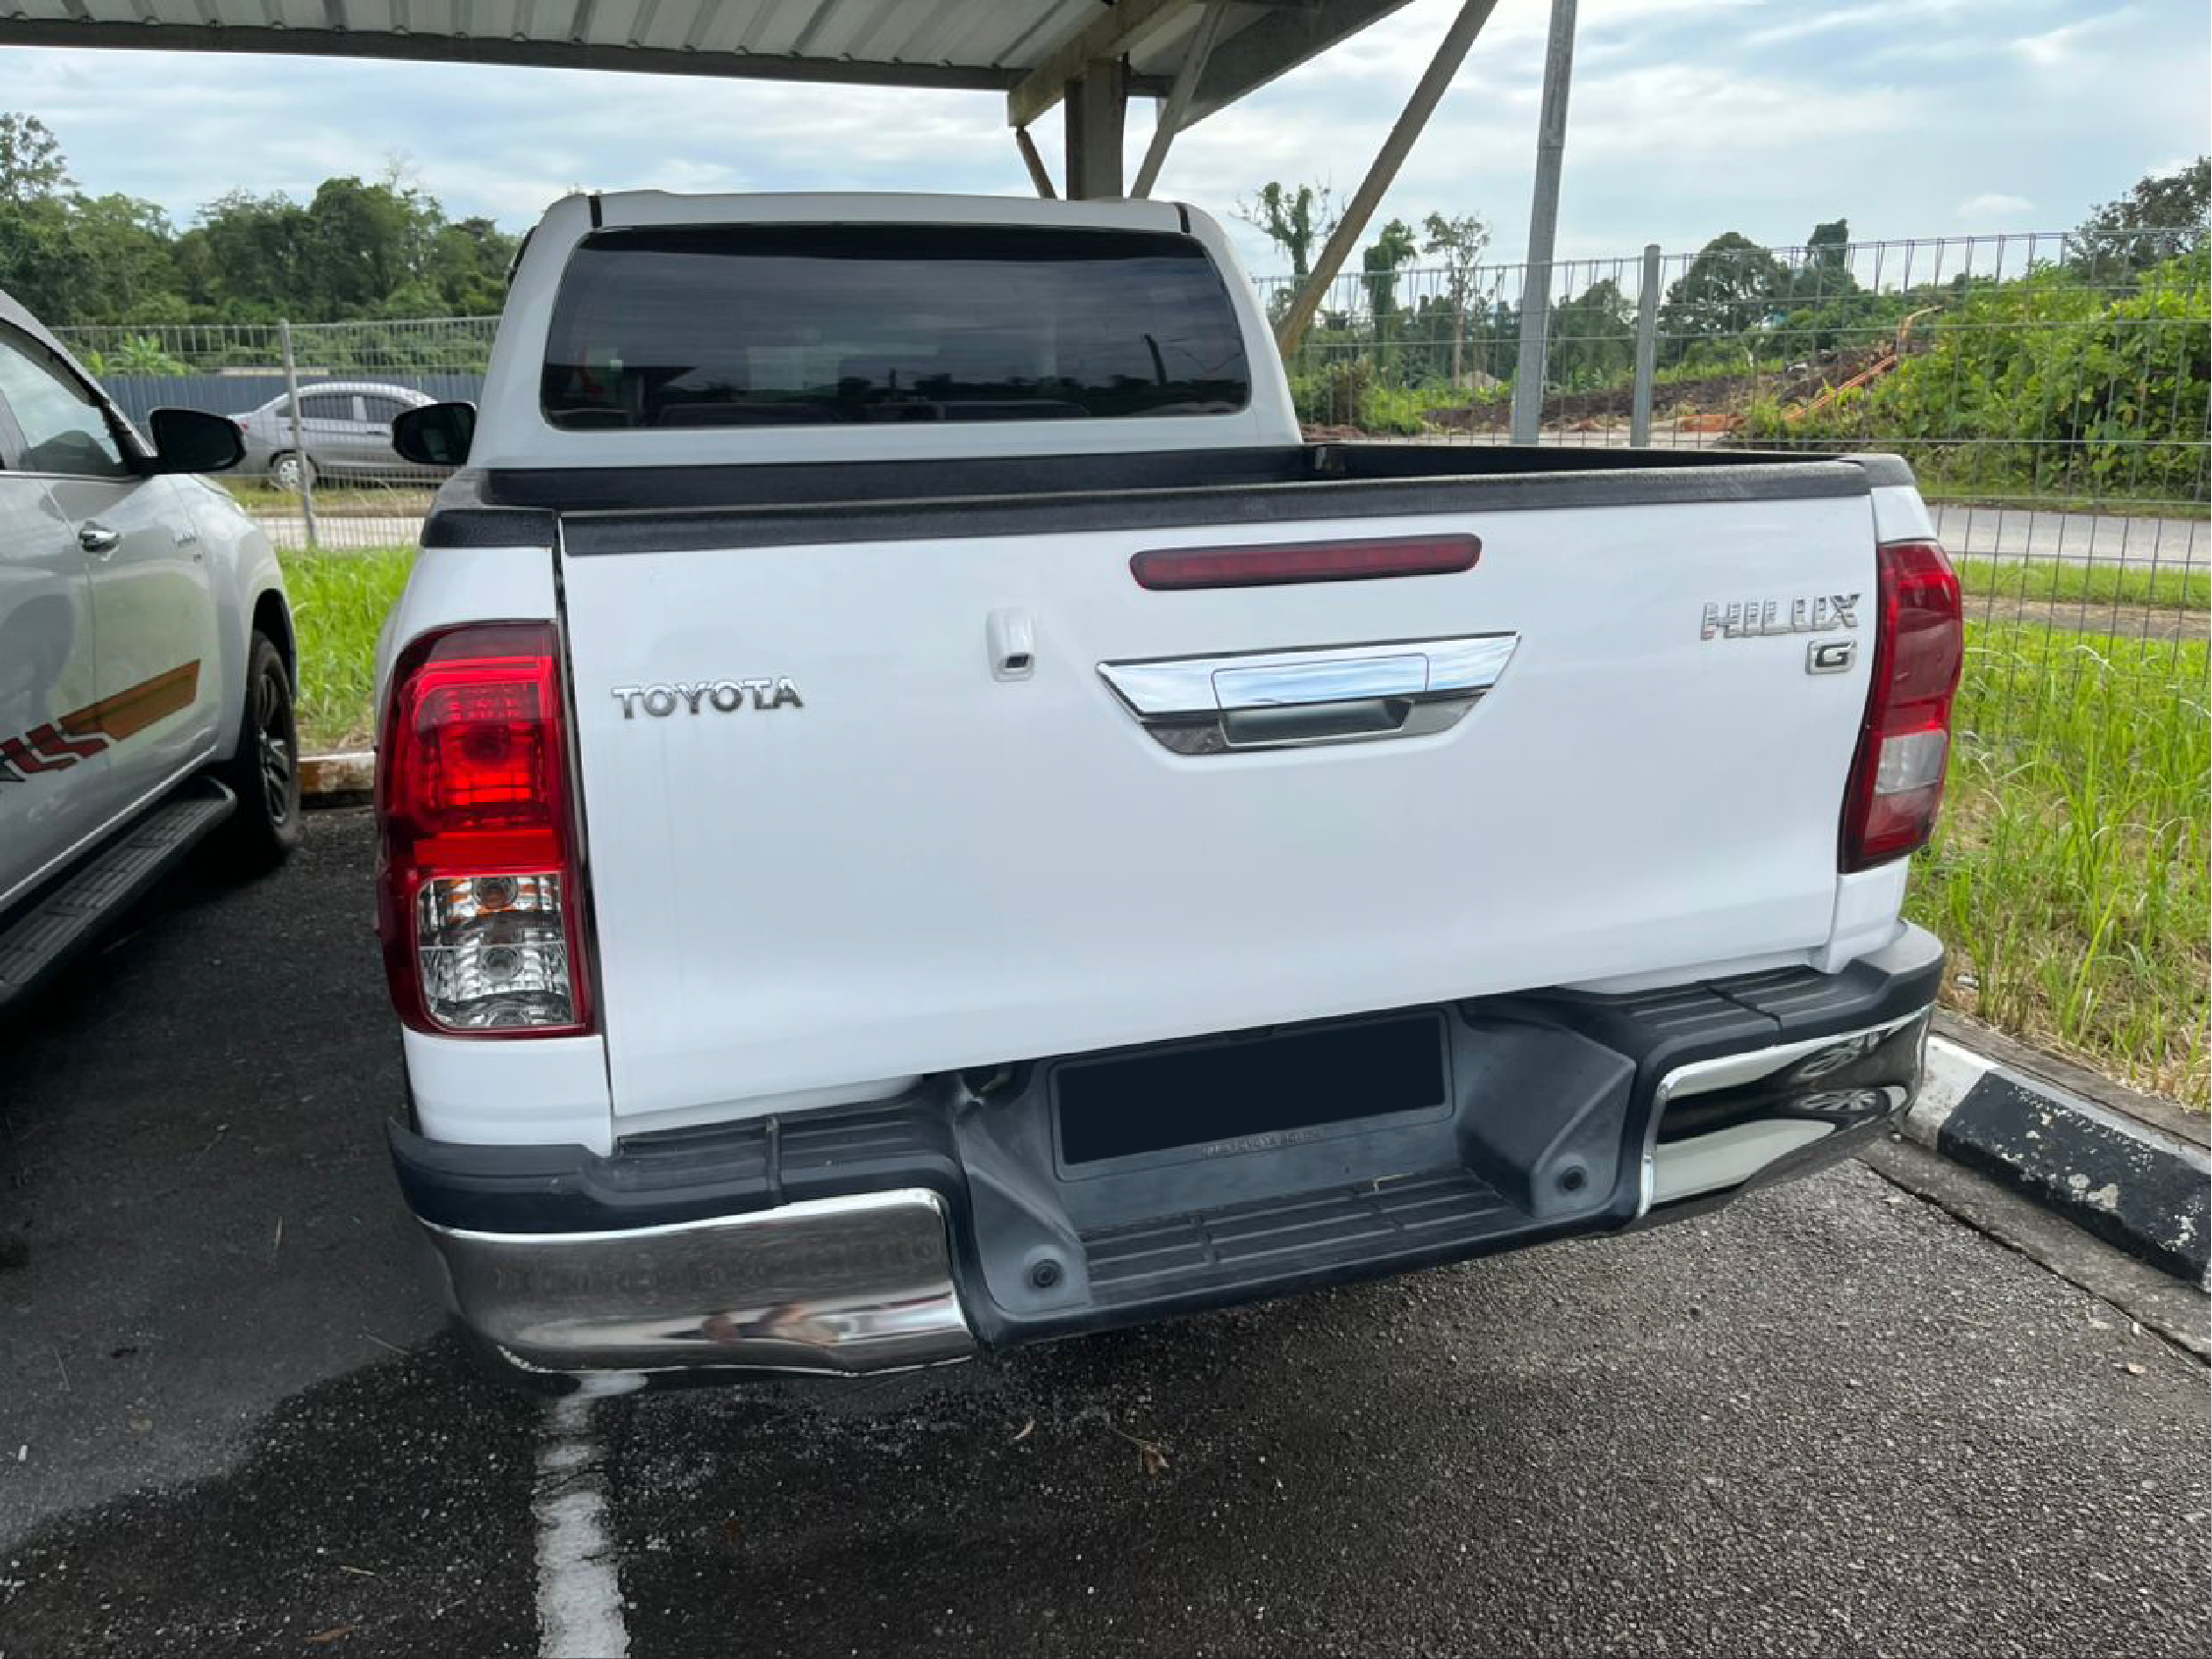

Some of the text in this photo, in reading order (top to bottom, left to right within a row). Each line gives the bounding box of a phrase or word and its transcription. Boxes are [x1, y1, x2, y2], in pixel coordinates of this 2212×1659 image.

[1701, 593, 1860, 640] HILUX
[1809, 640, 1855, 672] G
[611, 675, 804, 718] TOYOTA
